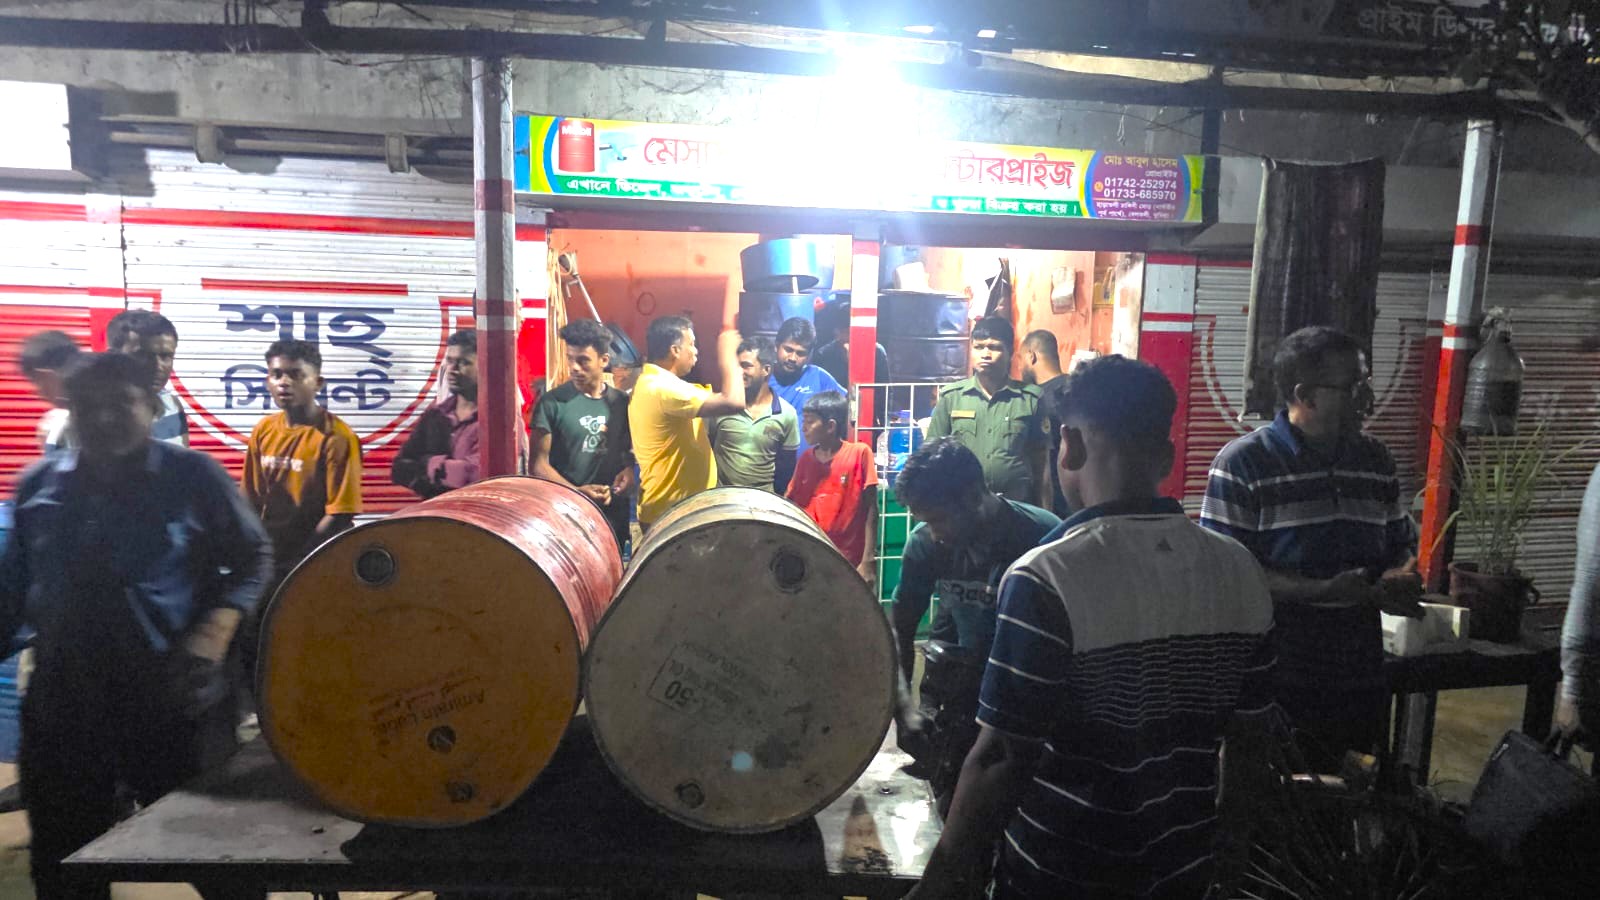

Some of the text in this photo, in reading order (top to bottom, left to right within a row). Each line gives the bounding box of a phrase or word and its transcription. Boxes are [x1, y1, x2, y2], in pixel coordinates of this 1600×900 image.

[1125, 156, 1149, 168] আবুল
[1104, 178, 1177, 190] 01742-252974
[1104, 189, 1176, 200] 01735-685970
